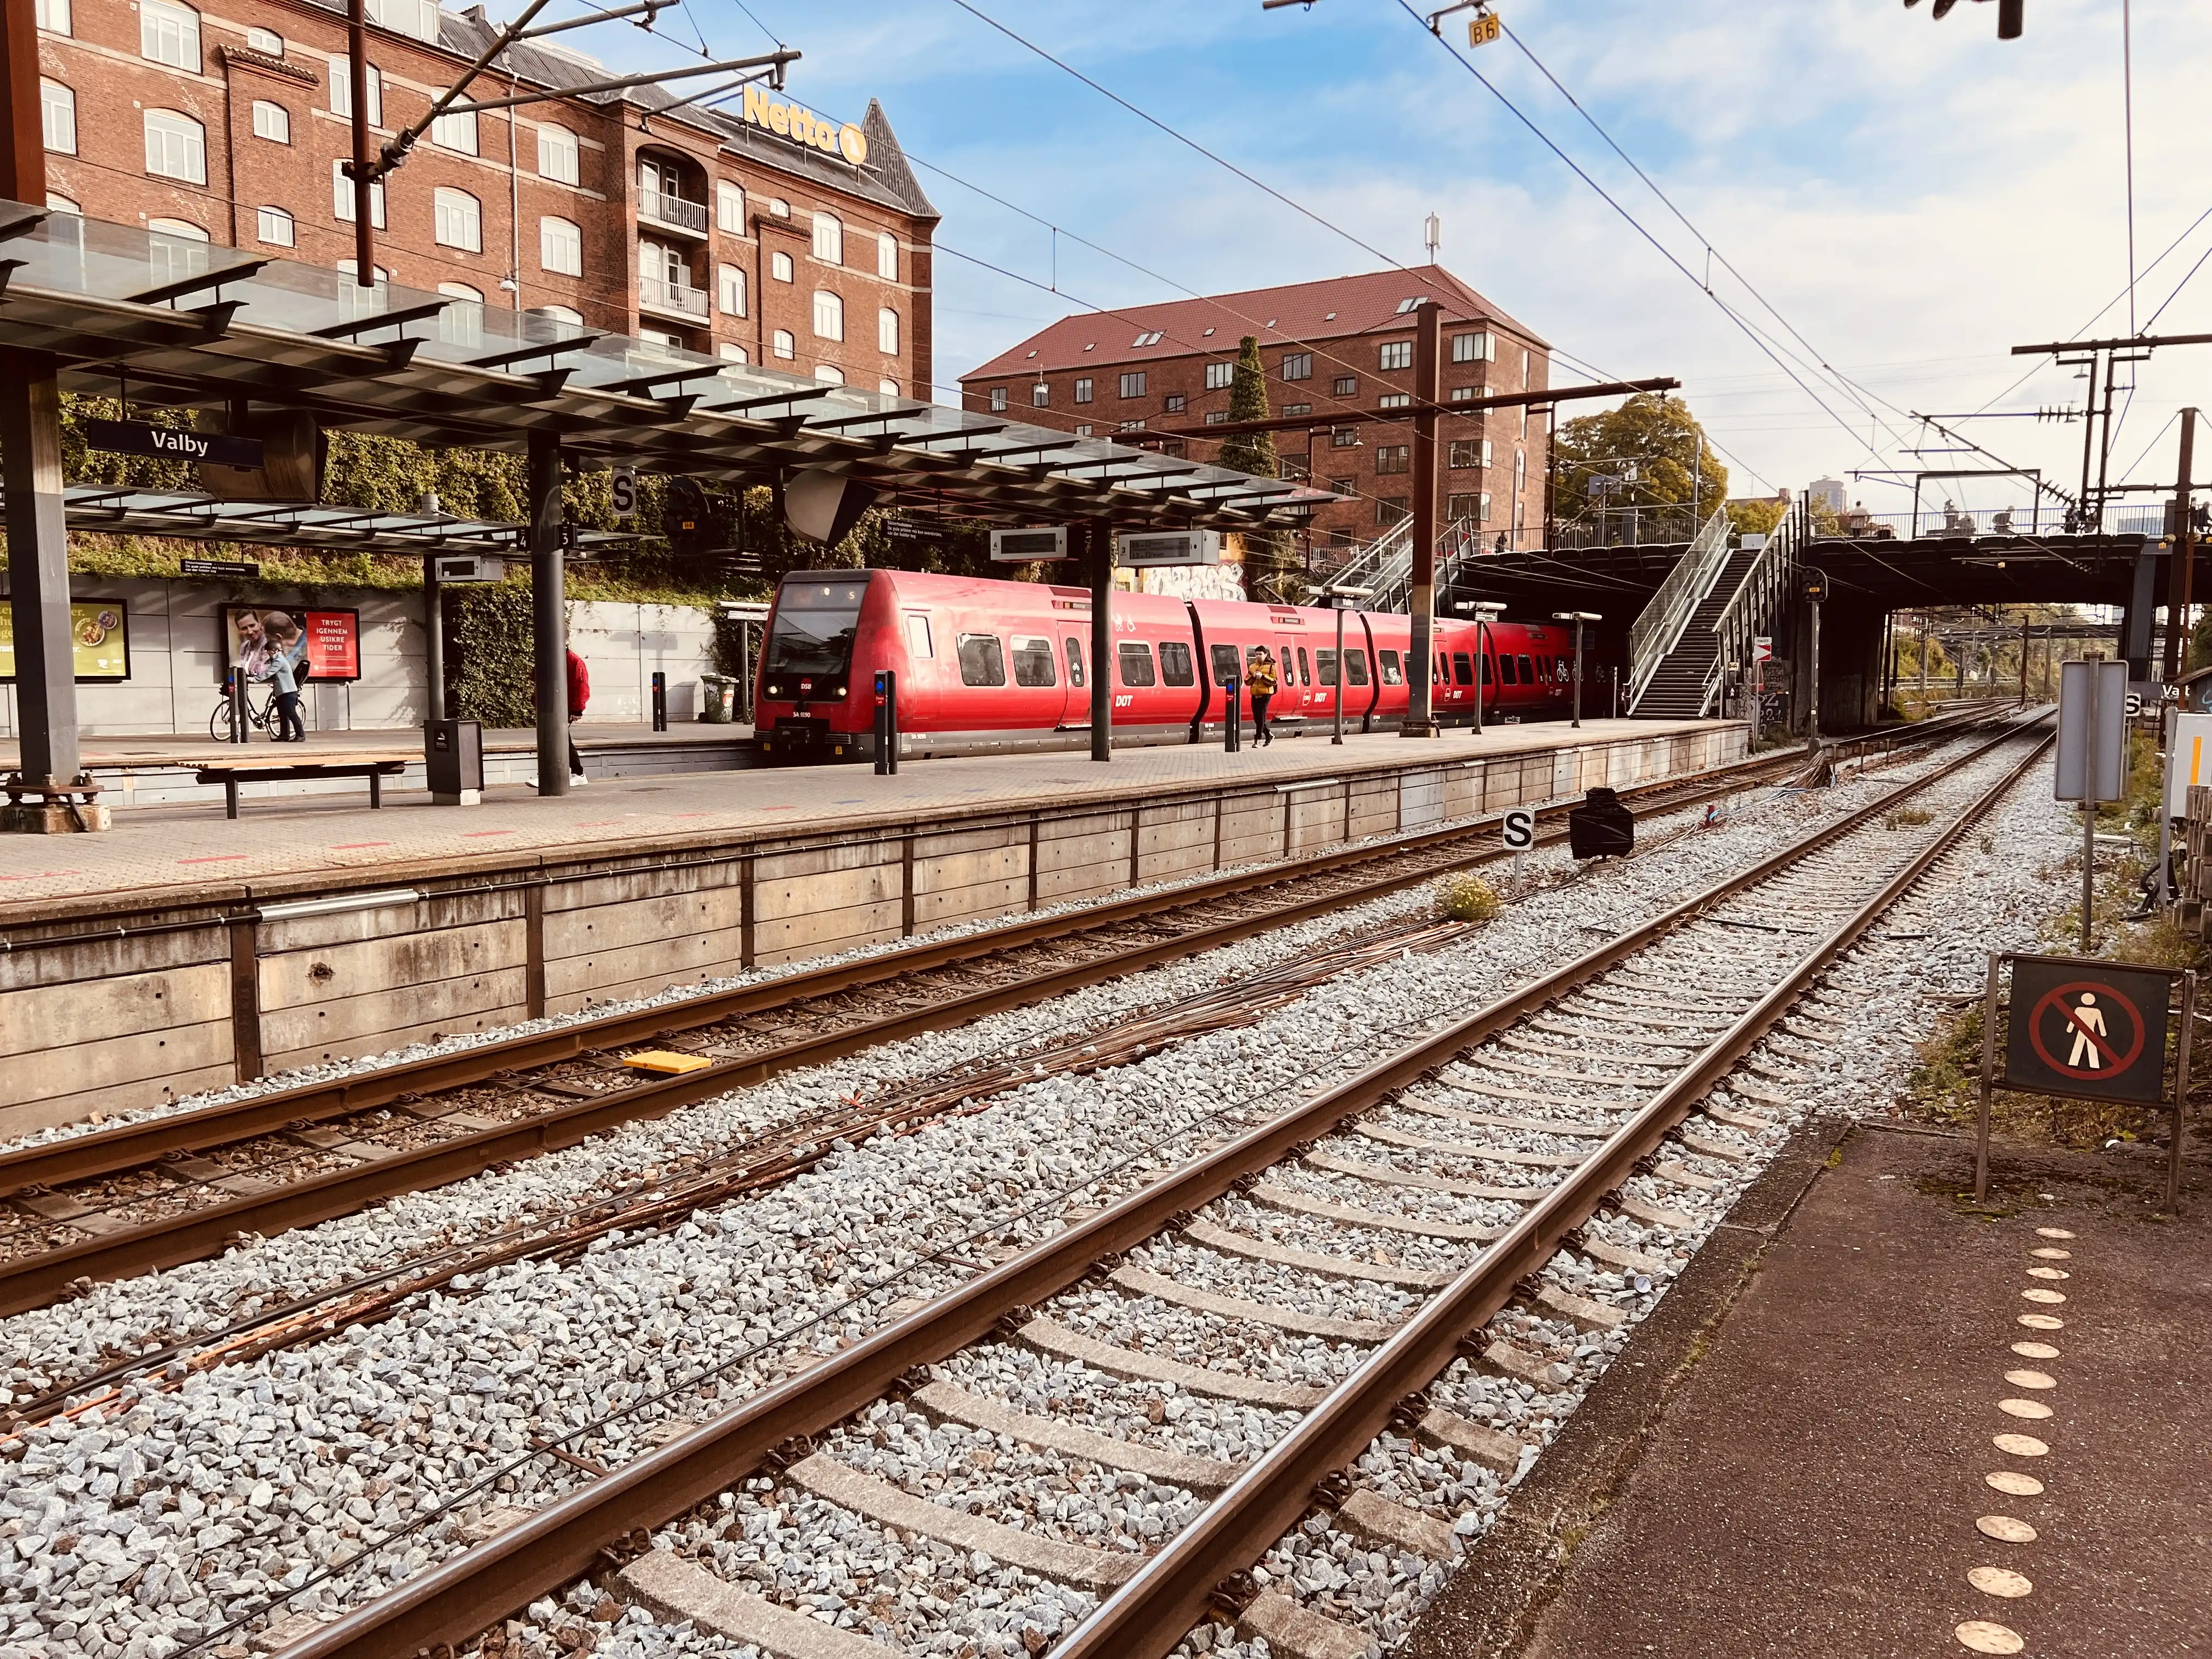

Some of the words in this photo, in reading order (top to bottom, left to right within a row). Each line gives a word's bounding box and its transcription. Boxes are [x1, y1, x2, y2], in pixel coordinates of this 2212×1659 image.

[1474, 22, 1495, 44] B6
[744, 85, 835, 152] Netto
[151, 431, 208, 456] Valby
[612, 475, 633, 511] S
[520, 535, 526, 547] 4
[562, 533, 568, 545] 3
[1115, 695, 1133, 707] DOT
[1314, 692, 1327, 703] DOT
[2126, 695, 2140, 714] S
[1504, 812, 1532, 847] S
